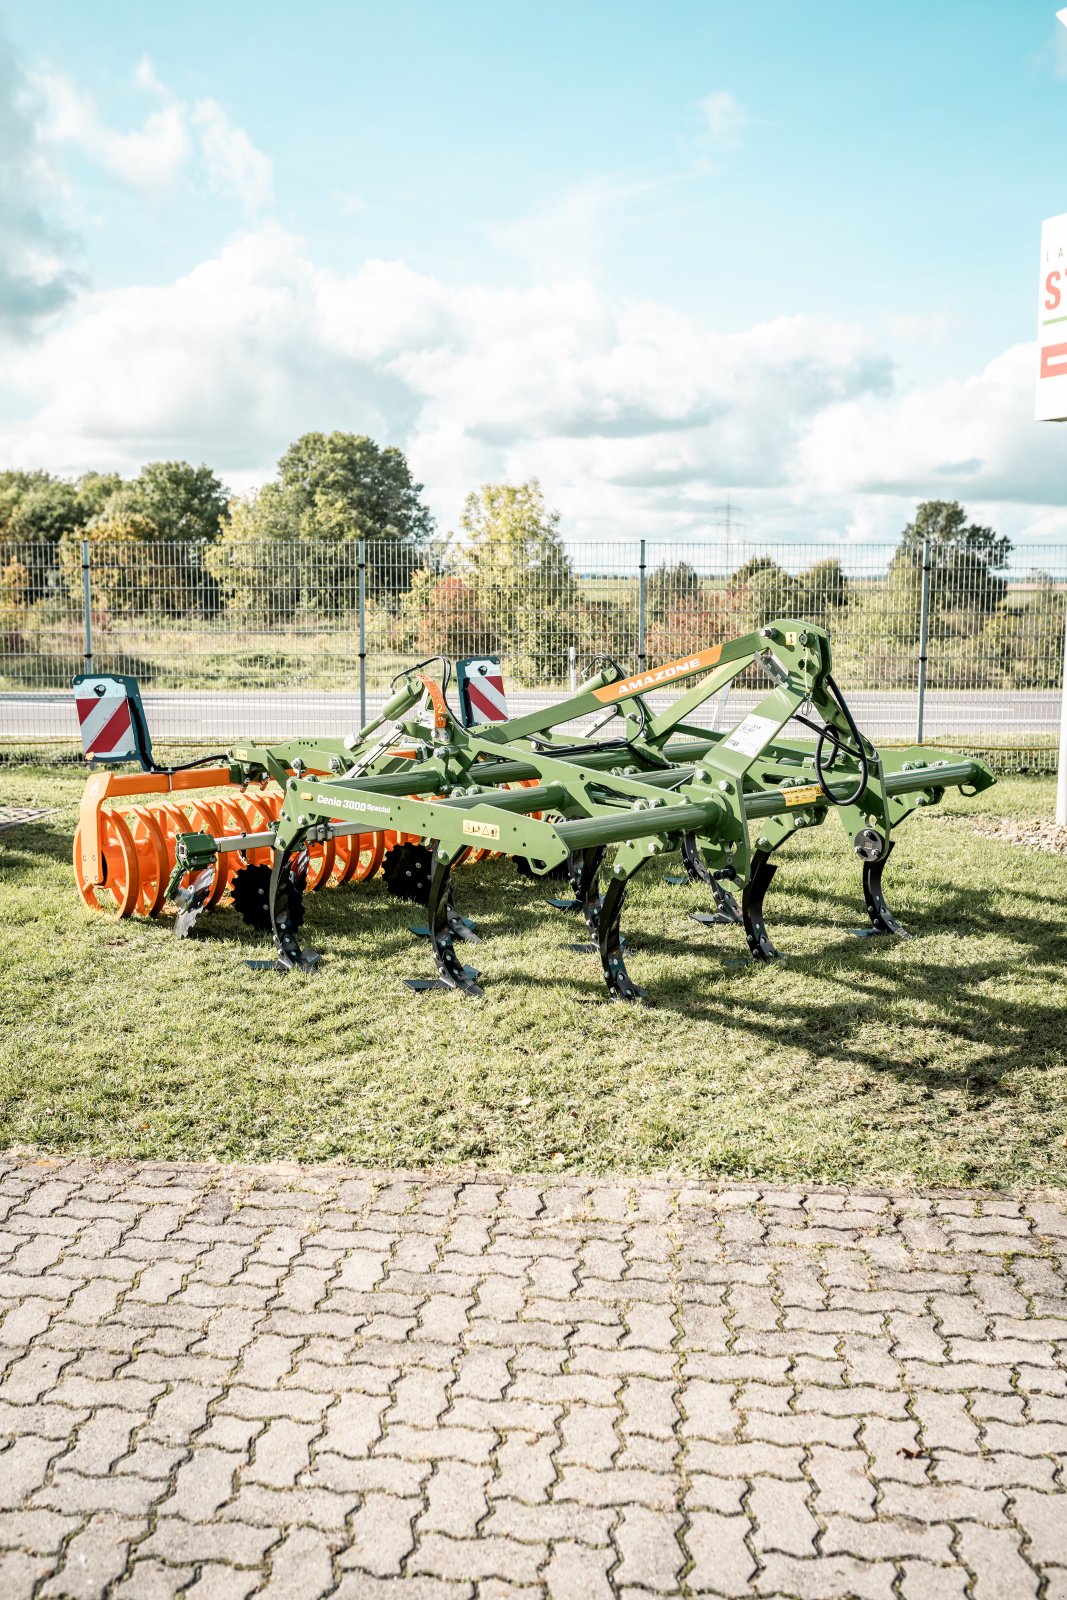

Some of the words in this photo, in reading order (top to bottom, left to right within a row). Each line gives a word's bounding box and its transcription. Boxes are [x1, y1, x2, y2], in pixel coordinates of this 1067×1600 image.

[1045, 267, 1067, 310] S
[618, 658, 701, 694] AMAZONE
[317, 794, 342, 807] Cenio
[343, 799, 366, 812] 3000
[367, 803, 391, 813] Special
